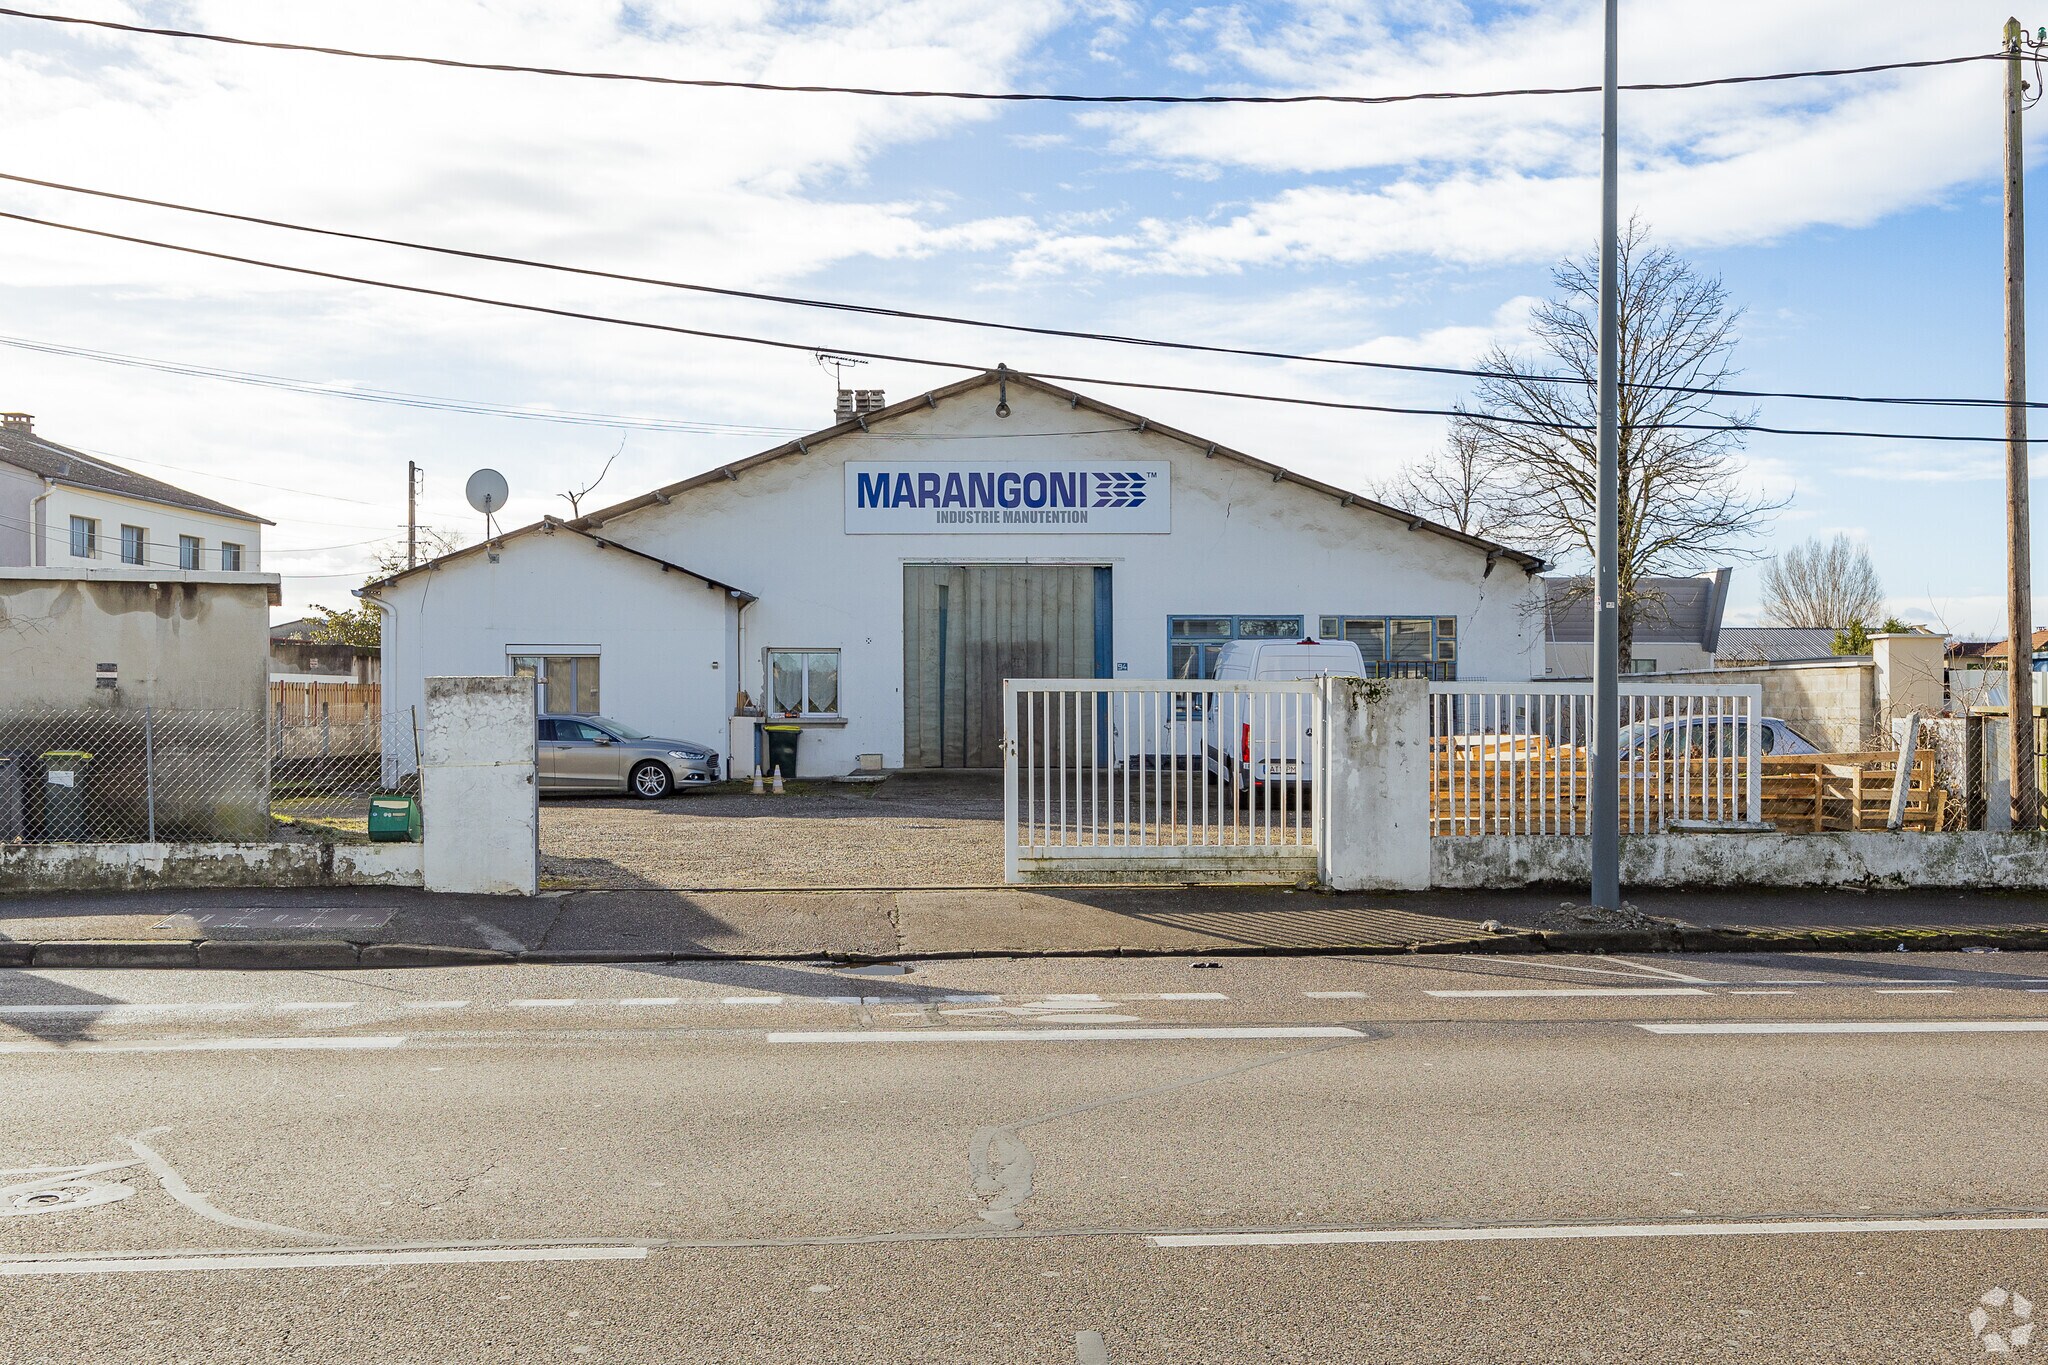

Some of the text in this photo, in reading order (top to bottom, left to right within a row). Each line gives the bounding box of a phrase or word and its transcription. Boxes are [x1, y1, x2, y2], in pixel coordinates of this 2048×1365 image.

[857, 472, 1088, 508] MARANGONI
[936, 510, 1088, 524] INDUSTRIE MANUTENTION
